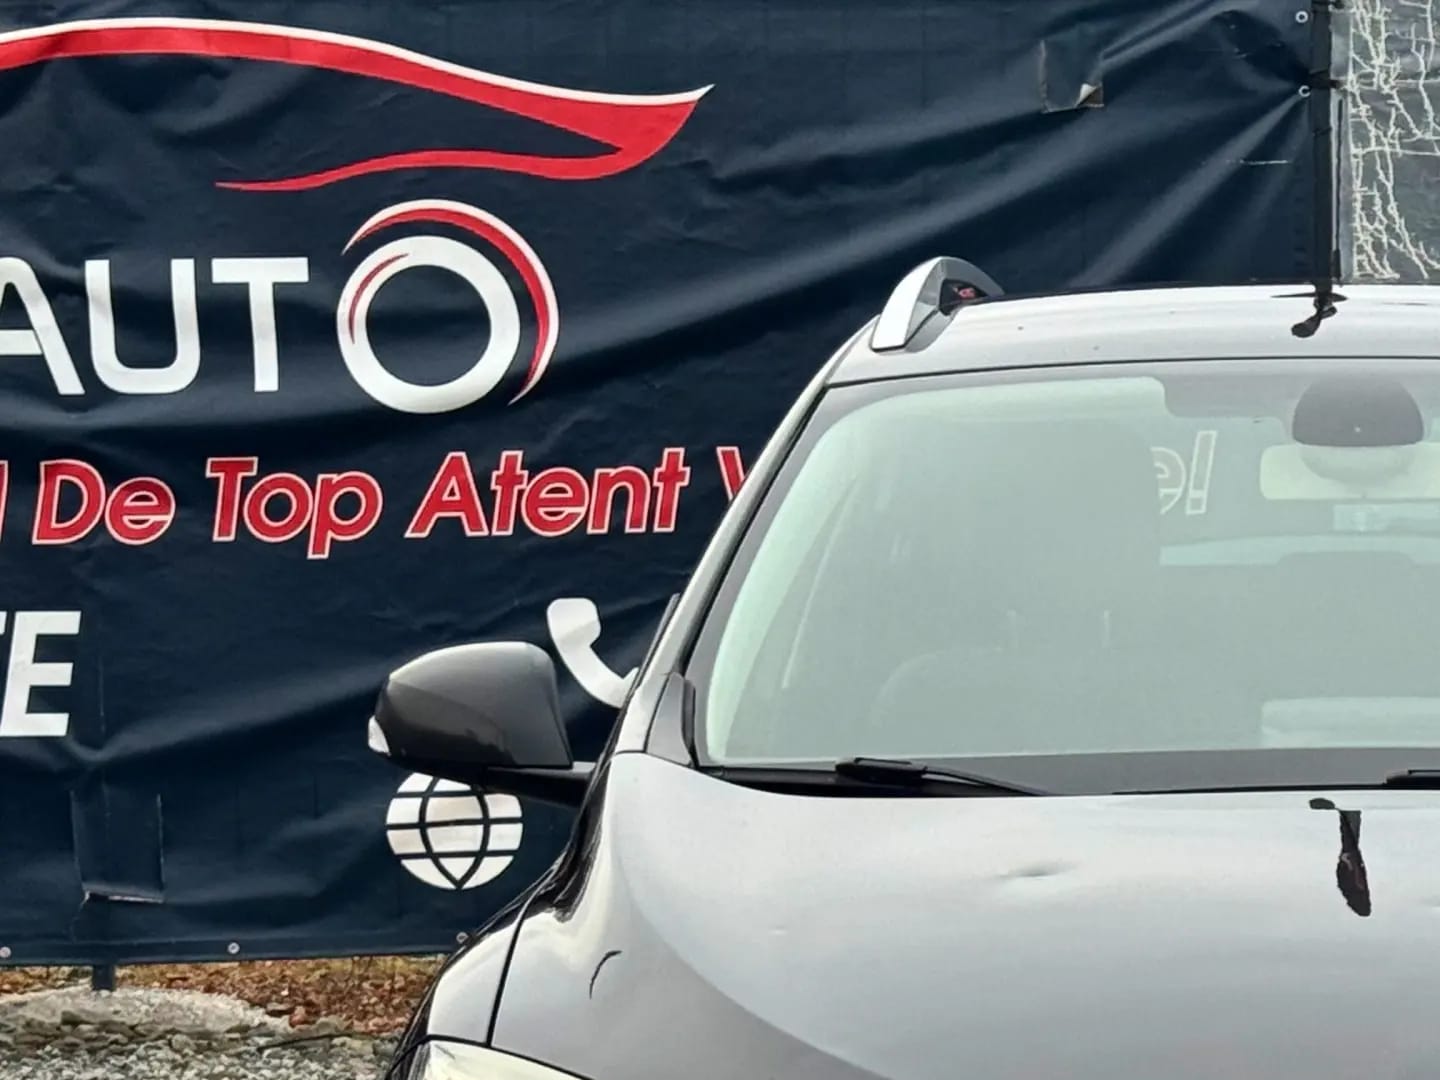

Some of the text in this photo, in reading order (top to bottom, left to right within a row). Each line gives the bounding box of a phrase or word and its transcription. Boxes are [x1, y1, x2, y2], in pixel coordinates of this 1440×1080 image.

[0, 235, 521, 414] AUTO
[32, 458, 176, 545] De
[205, 456, 384, 559] Top
[405, 447, 692, 539] Atent
[0, 610, 82, 737] E
